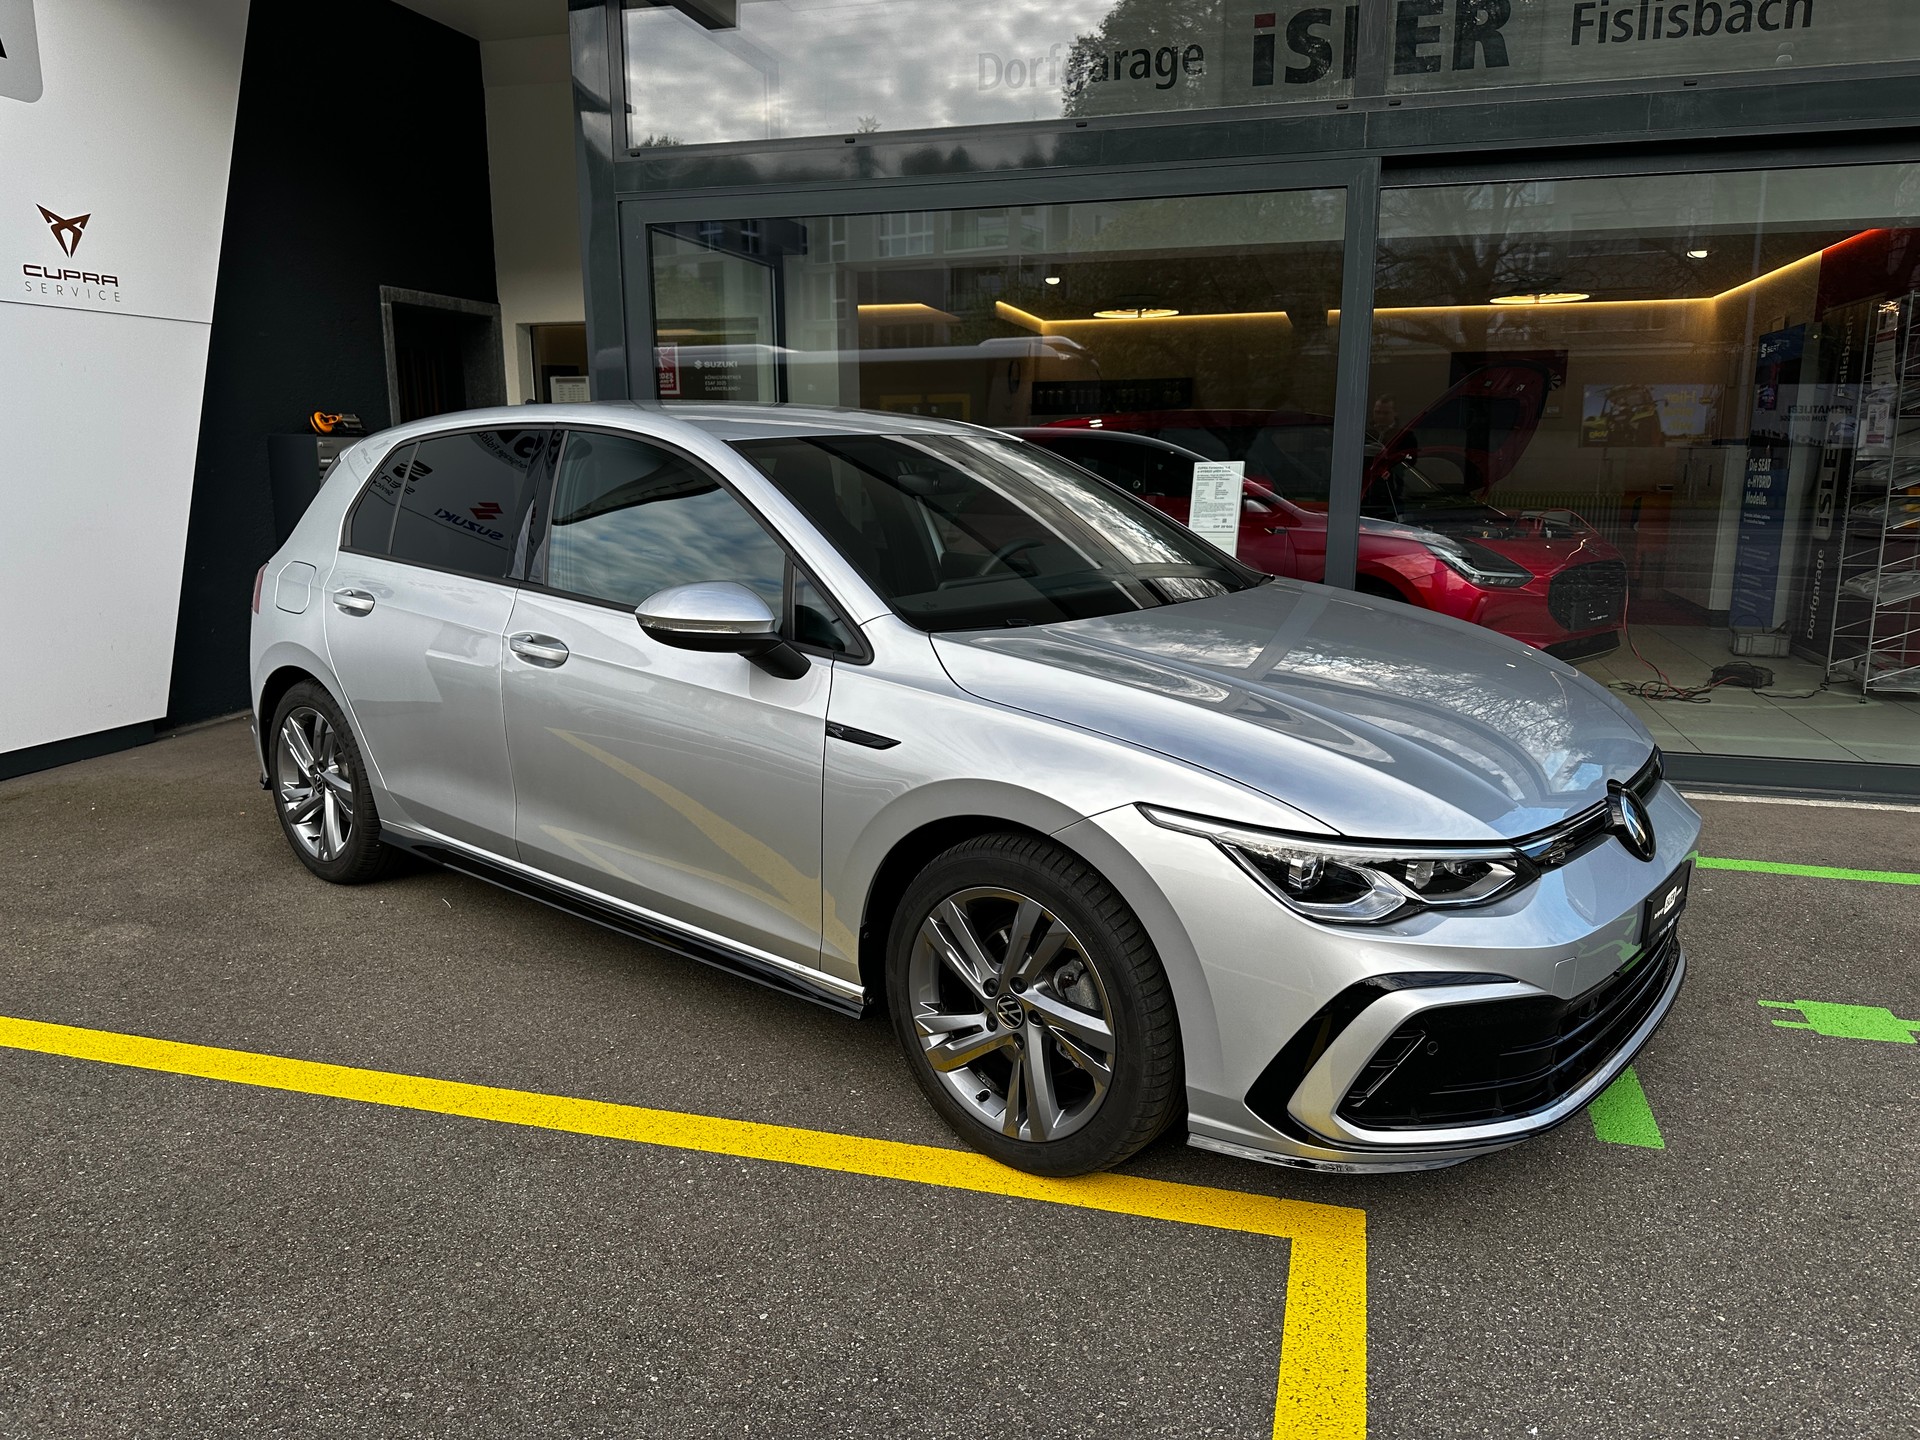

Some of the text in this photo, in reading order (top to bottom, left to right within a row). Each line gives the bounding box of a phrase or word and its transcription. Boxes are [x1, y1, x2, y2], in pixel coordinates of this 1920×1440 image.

[978, 43, 1204, 94] Dorfgarage
[1571, 0, 1814, 46] Fislisbach
[23, 264, 119, 287] CUPRA
[24, 281, 121, 302] SERVICE
[704, 361, 738, 369] SUZUKI
[1749, 458, 1772, 472] Die SEAT
[1747, 475, 1772, 489] e-HYBRID
[1806, 549, 1825, 640] Dorfgarage
[1837, 315, 1854, 397] Fislisbach
